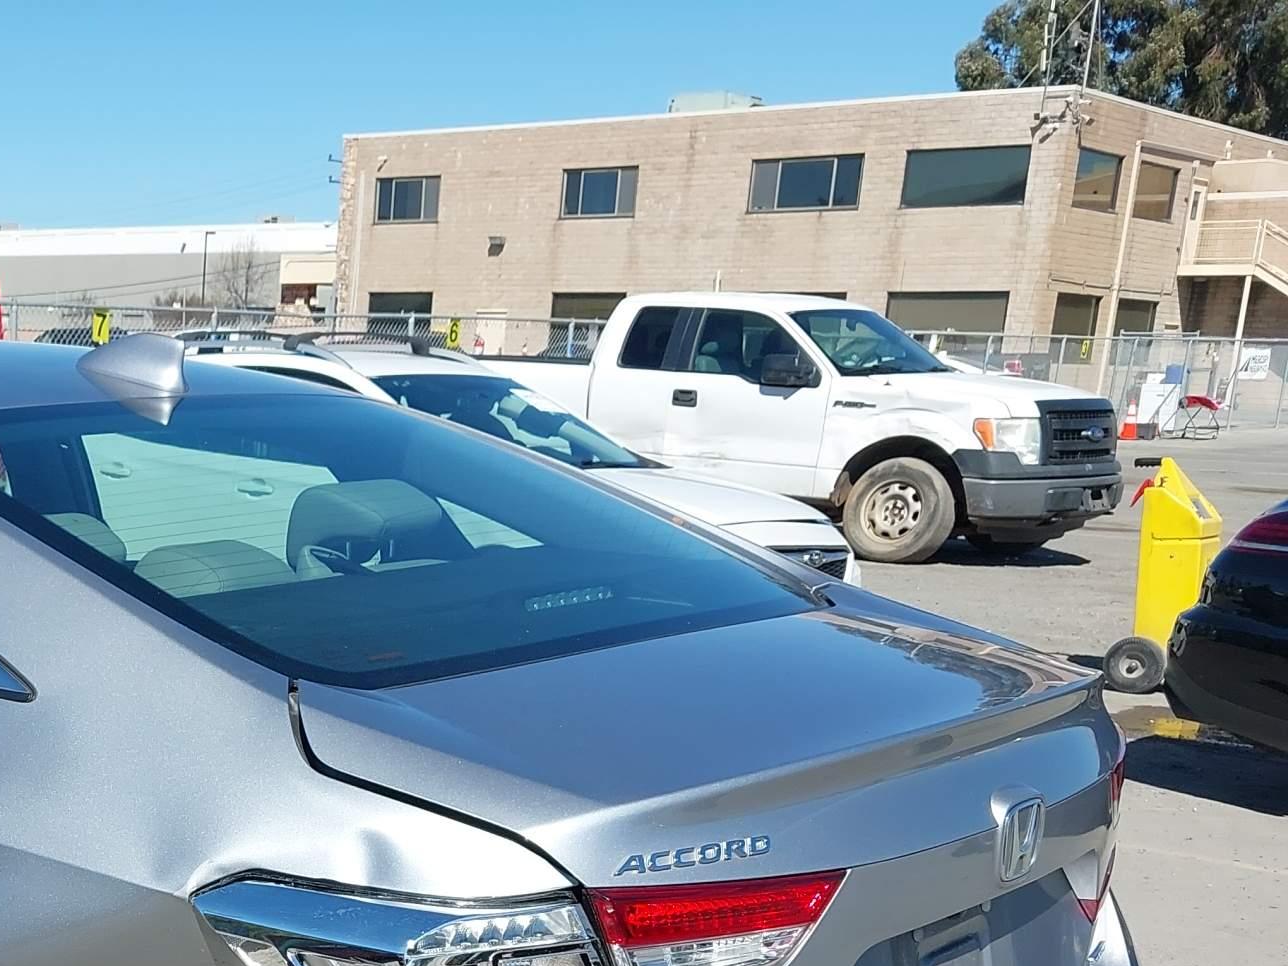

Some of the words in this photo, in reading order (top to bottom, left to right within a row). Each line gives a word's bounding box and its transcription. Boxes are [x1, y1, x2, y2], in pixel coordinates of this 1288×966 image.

[95, 313, 107, 337] 7
[449, 322, 459, 343] 6
[612, 835, 771, 877] ACCORD
